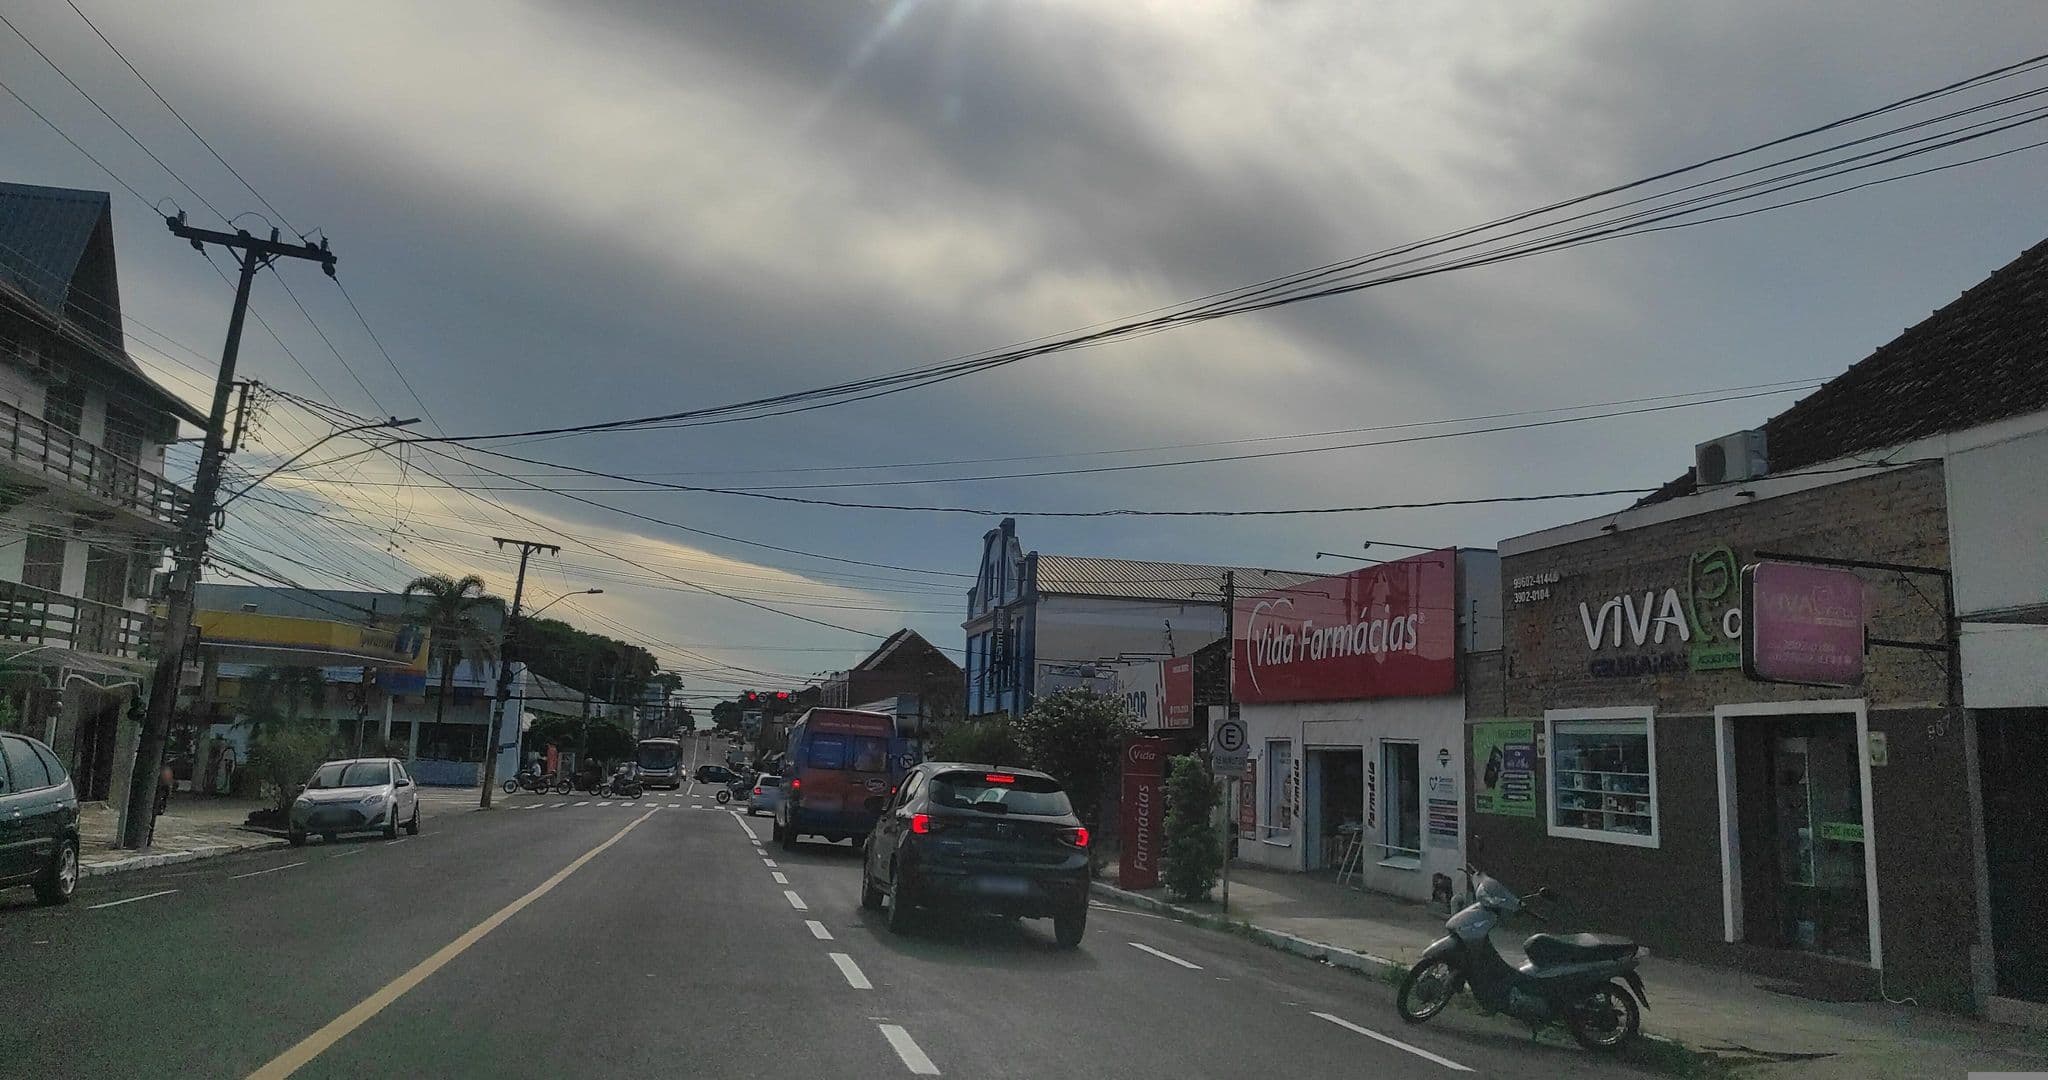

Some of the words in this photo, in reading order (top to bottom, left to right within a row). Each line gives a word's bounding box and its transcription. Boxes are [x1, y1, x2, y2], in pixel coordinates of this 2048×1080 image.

[1257, 624, 1295, 667] Vida
[1299, 603, 1418, 662] Farmácias
[1579, 588, 1690, 650] VIVA
[1134, 749, 1155, 761] Vida
[1225, 728, 1236, 745] E
[1133, 784, 1150, 872] Farmácias
